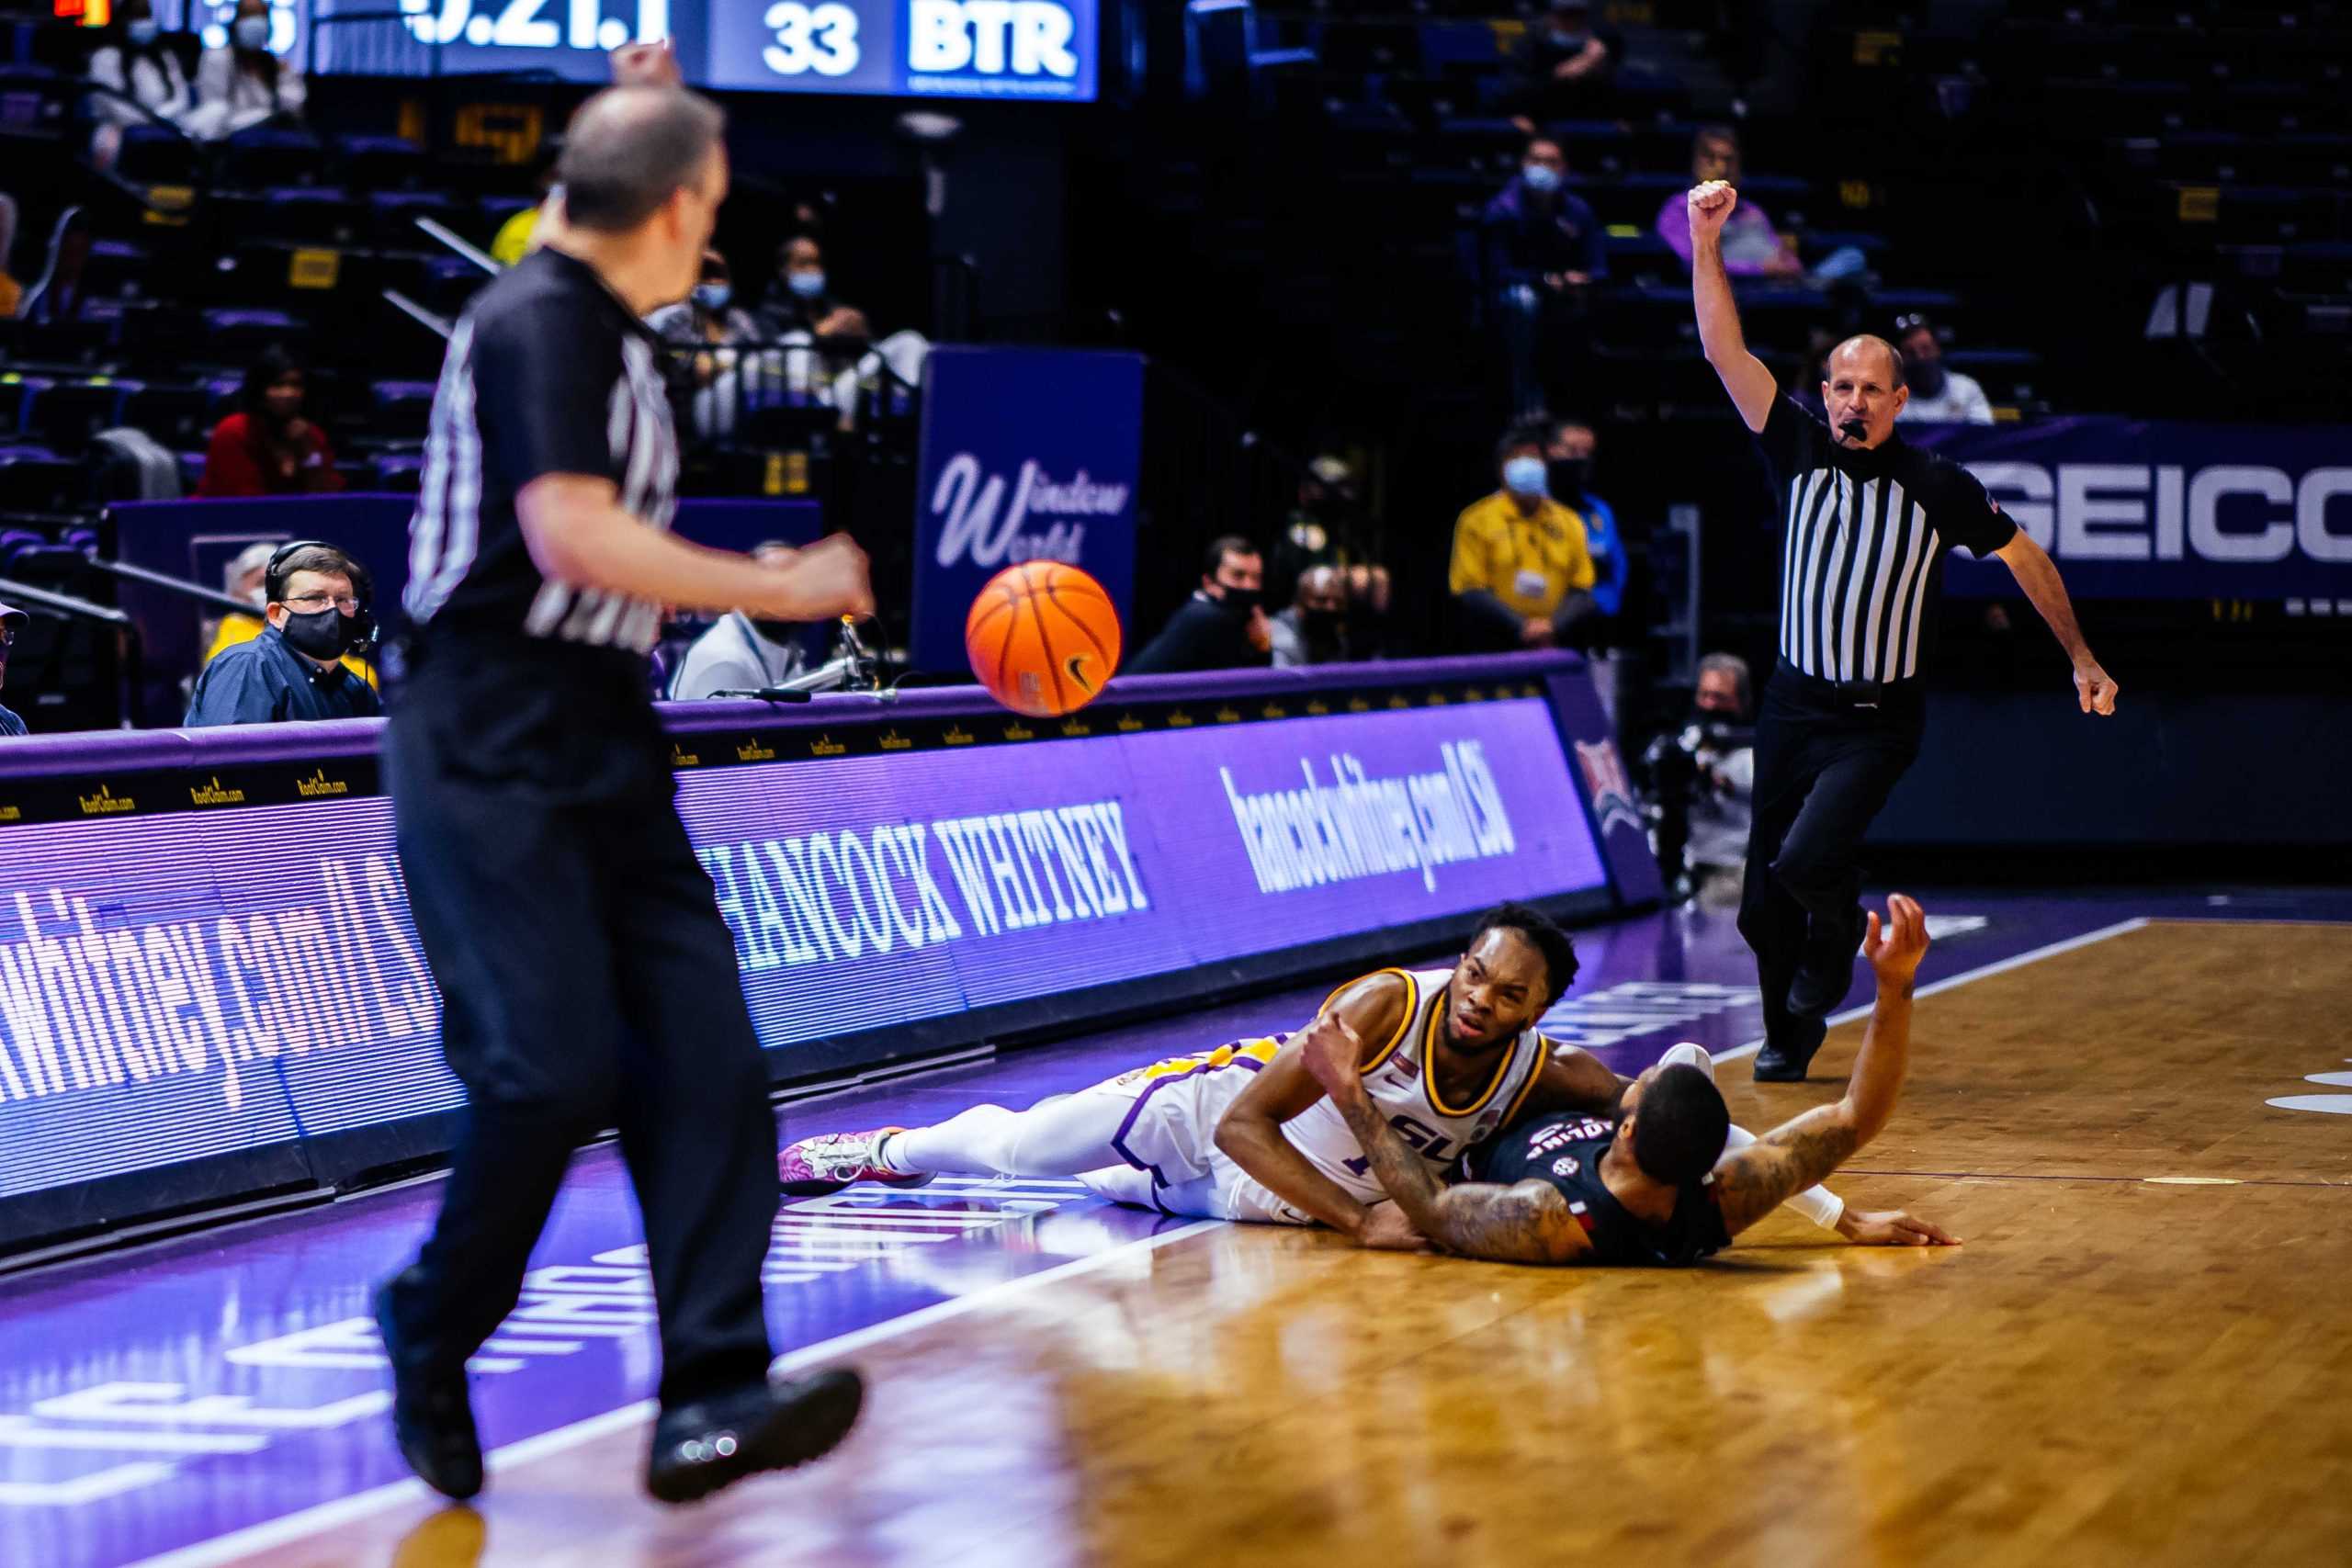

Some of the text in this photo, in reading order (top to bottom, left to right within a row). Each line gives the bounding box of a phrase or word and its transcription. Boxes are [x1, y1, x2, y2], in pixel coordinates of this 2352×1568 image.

[763, 1, 860, 75] 33
[908, 0, 1079, 77] BTR
[933, 801, 1147, 936] WHITNEY
